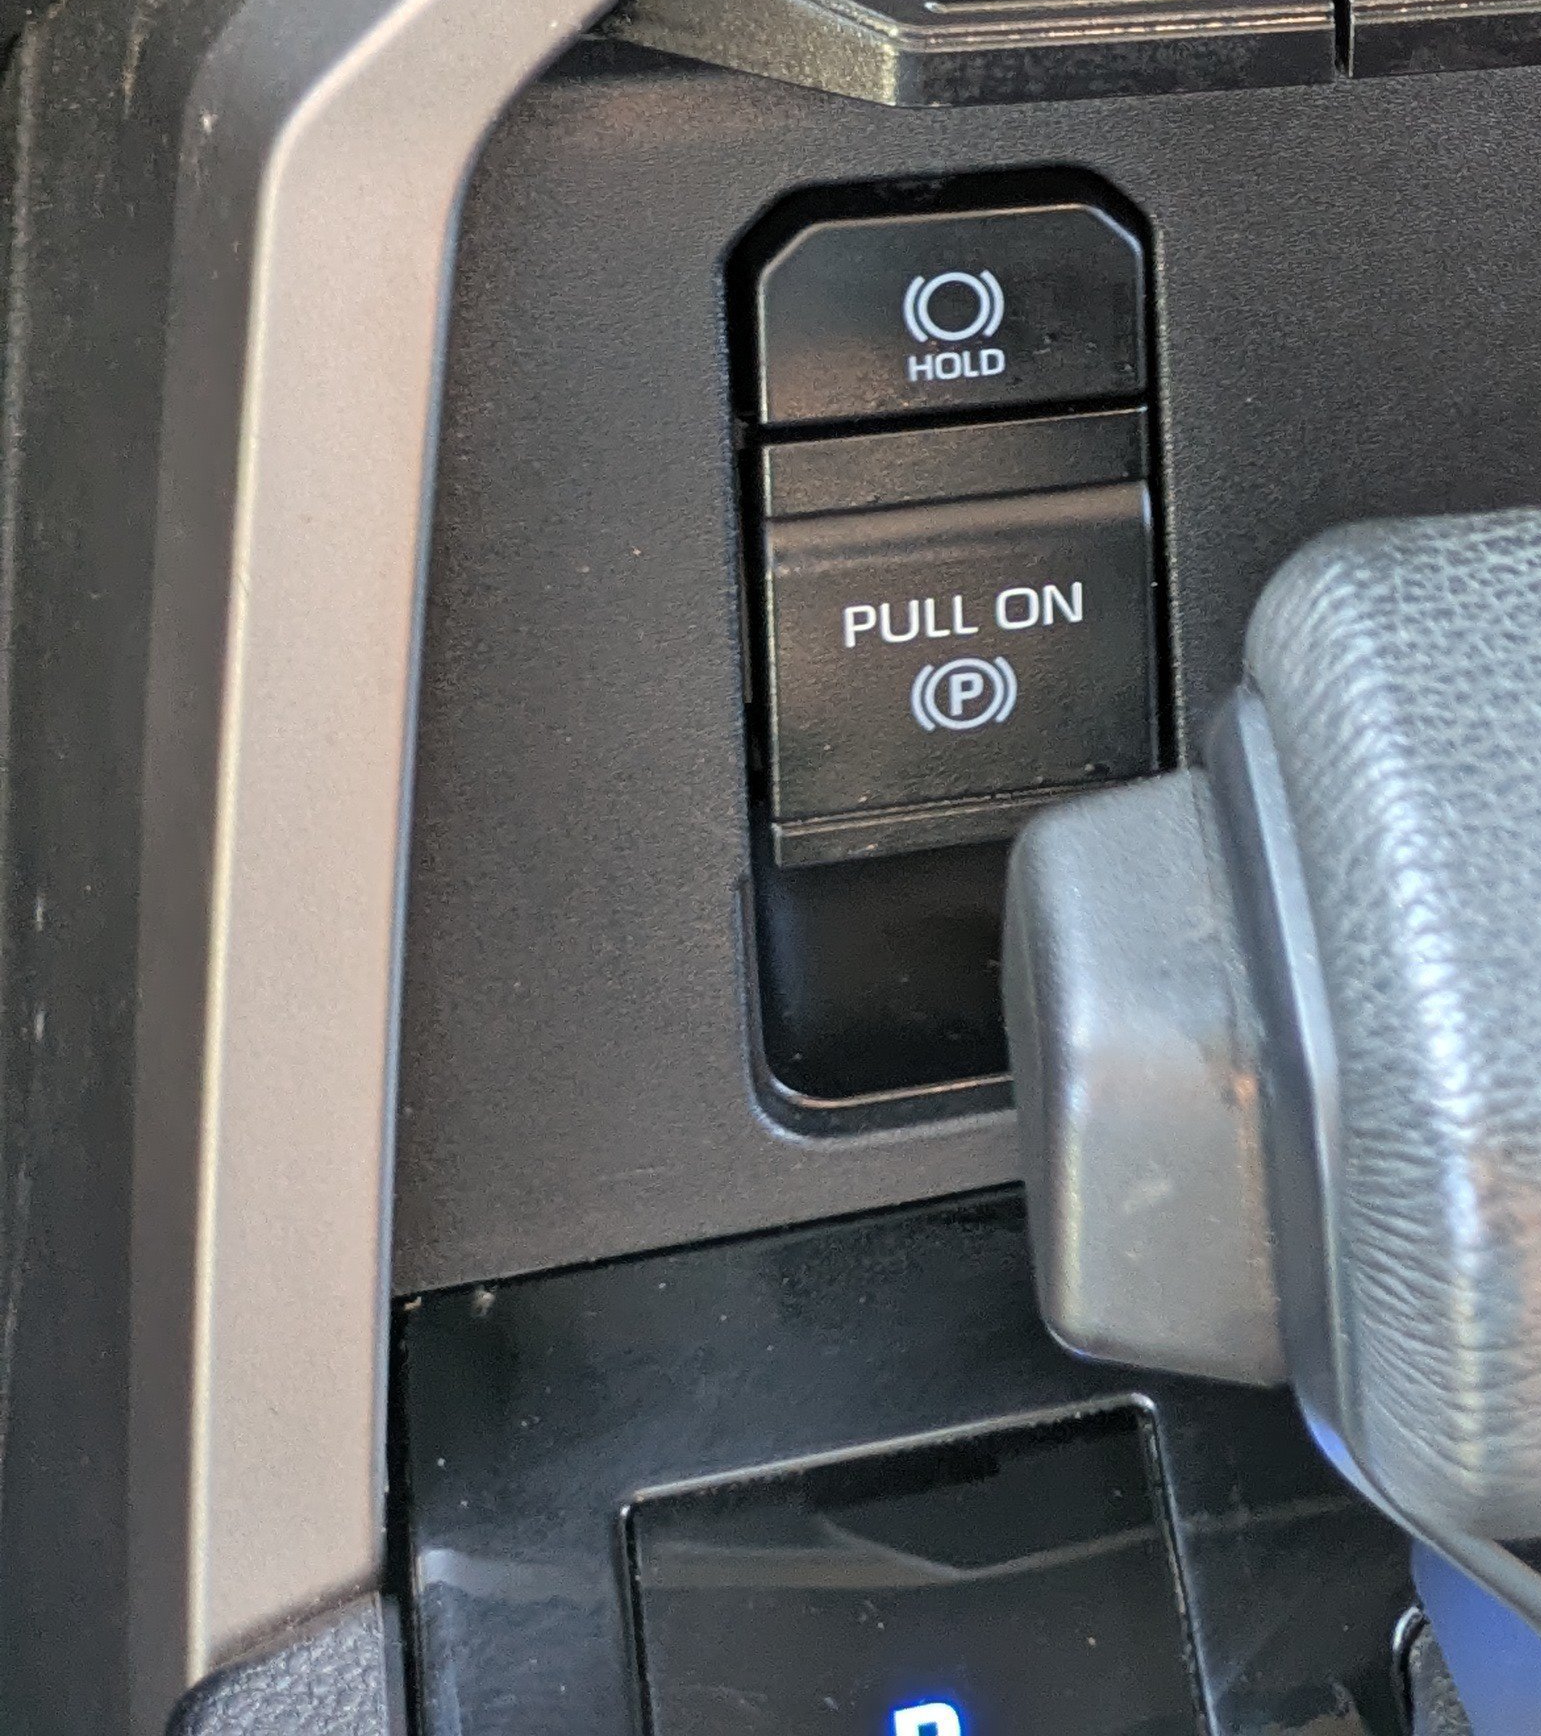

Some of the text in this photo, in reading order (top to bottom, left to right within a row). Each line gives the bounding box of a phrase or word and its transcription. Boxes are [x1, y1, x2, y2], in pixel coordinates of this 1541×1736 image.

[908, 348, 1005, 381] HOLD
[843, 581, 1083, 648] PULL ON
